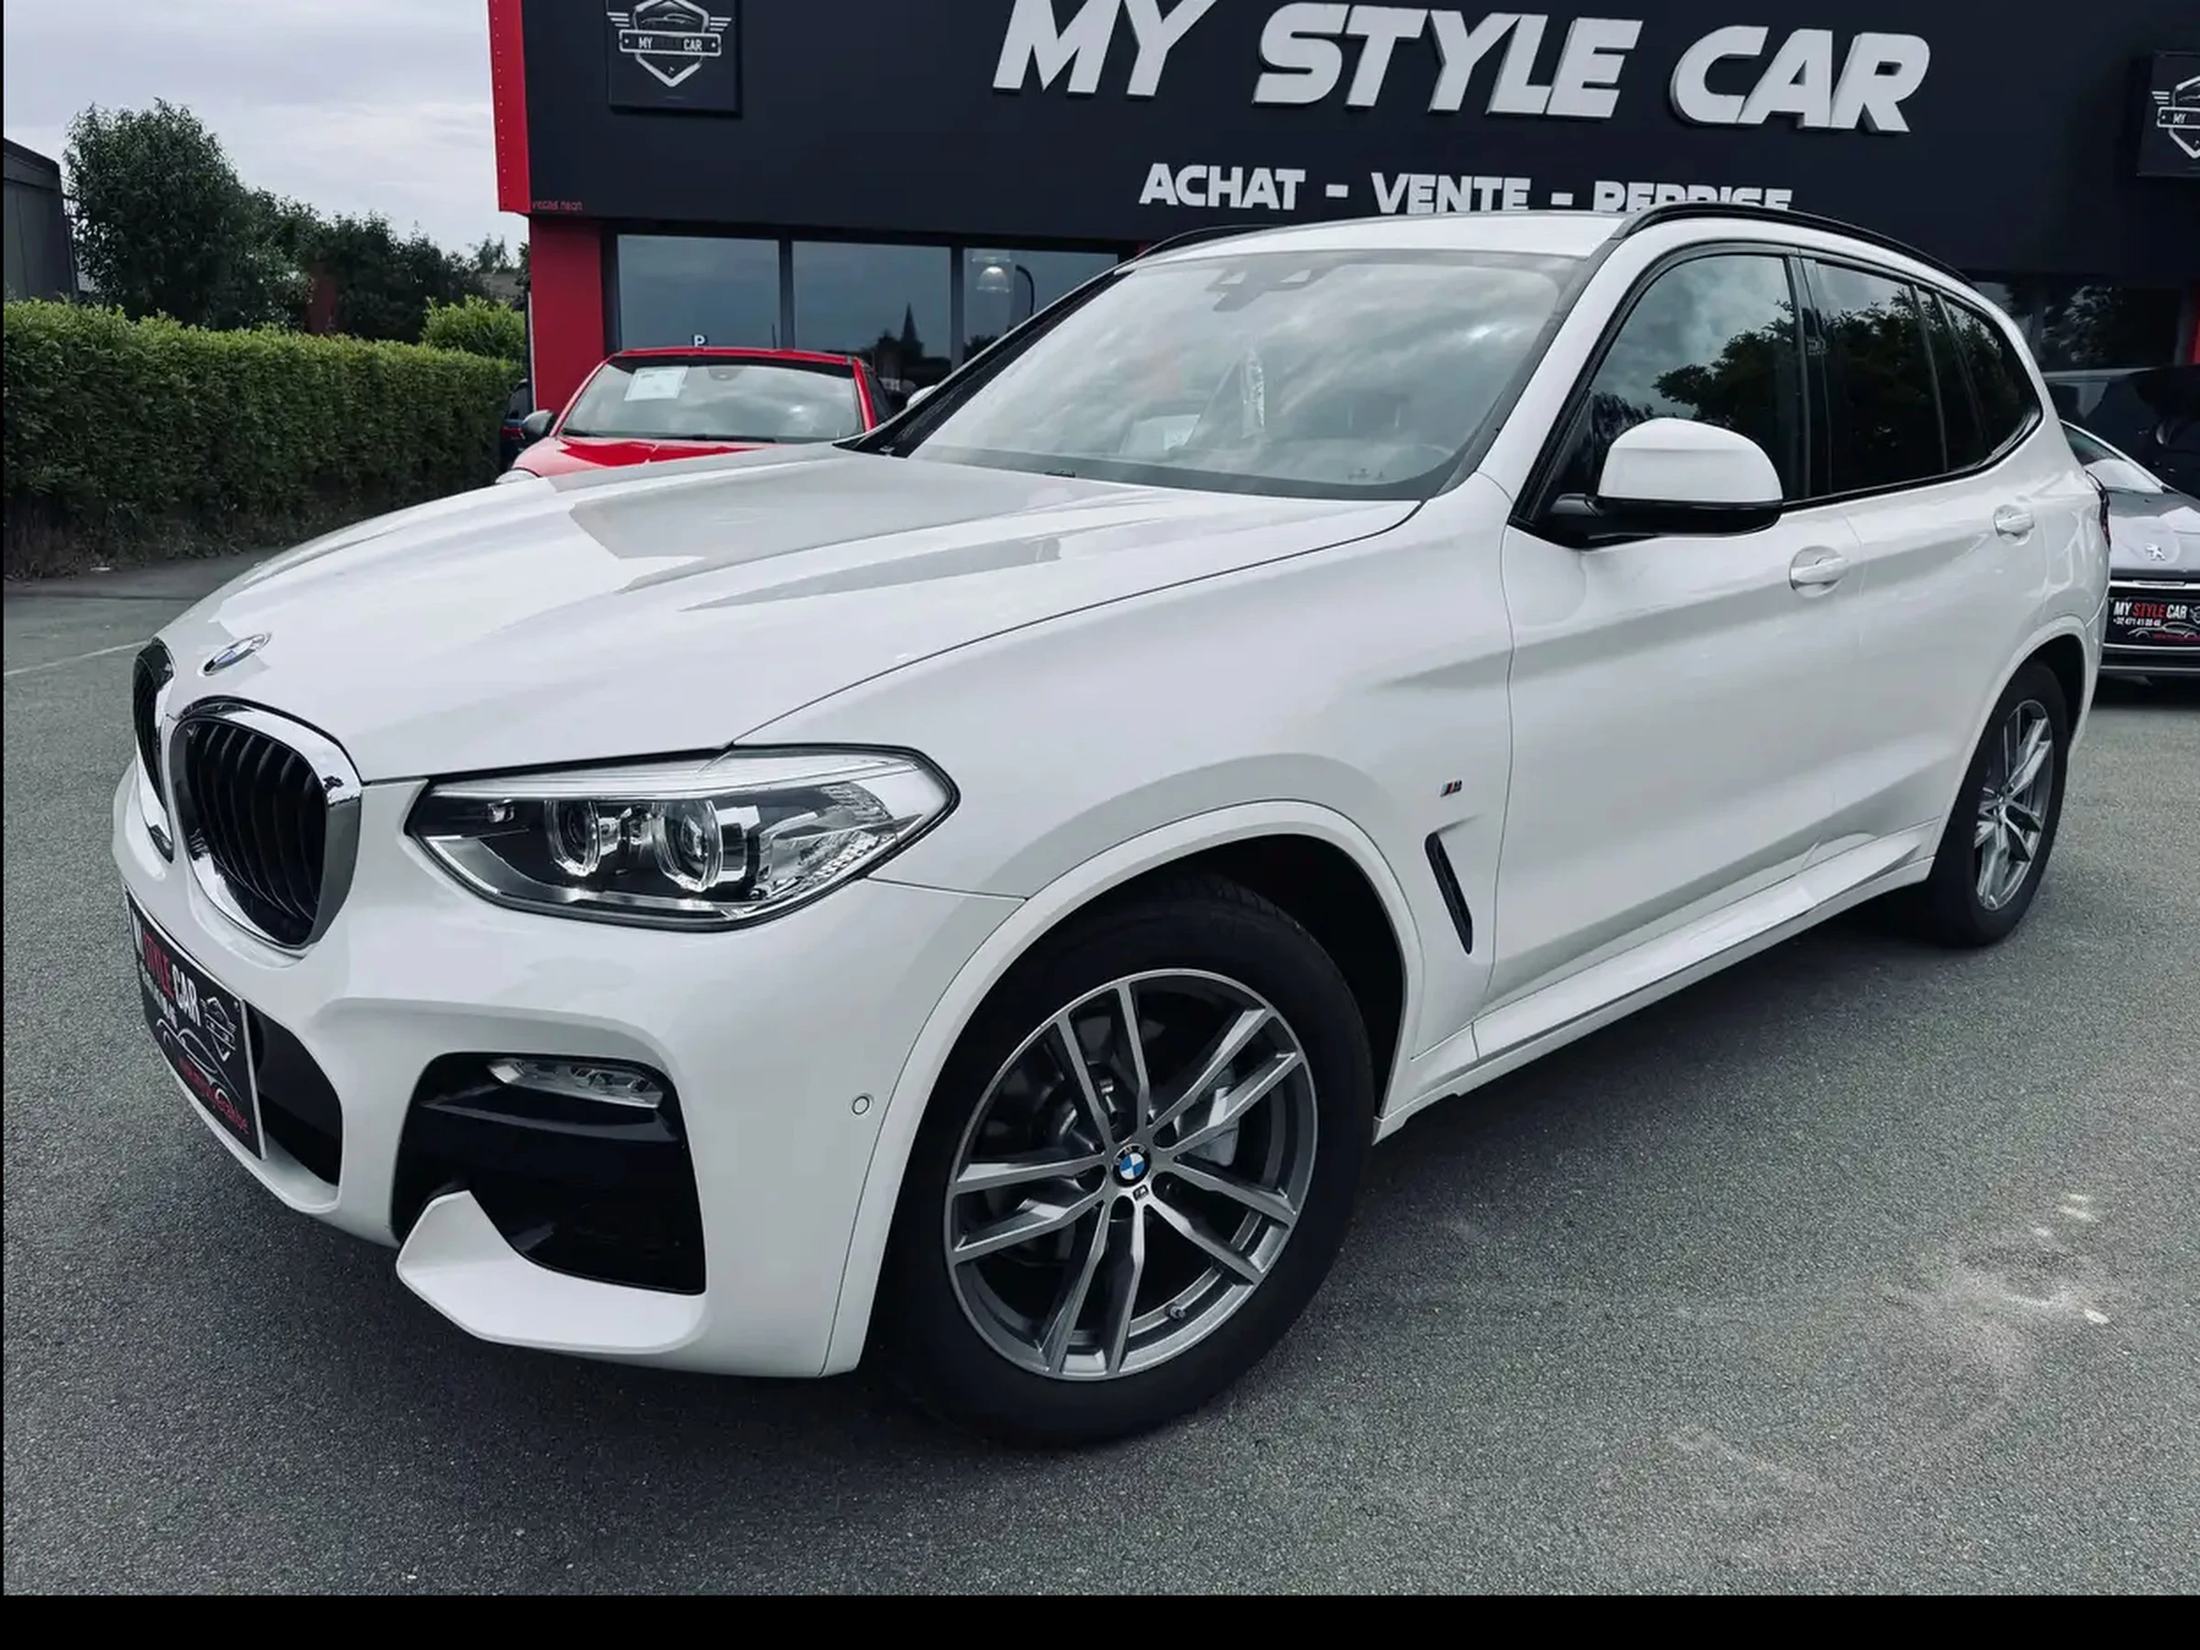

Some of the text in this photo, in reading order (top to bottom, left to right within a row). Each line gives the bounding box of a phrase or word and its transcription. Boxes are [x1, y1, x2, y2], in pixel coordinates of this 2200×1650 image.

[638, 36, 653, 50] MY
[683, 38, 703, 52] CAR
[993, 0, 1930, 132] MY STYLE CAR
[1139, 163, 1306, 210] ACHAT
[1371, 172, 1531, 214] VENTE
[2113, 601, 2188, 619] MY STYLE CAR
[171, 963, 200, 1027] CAR
